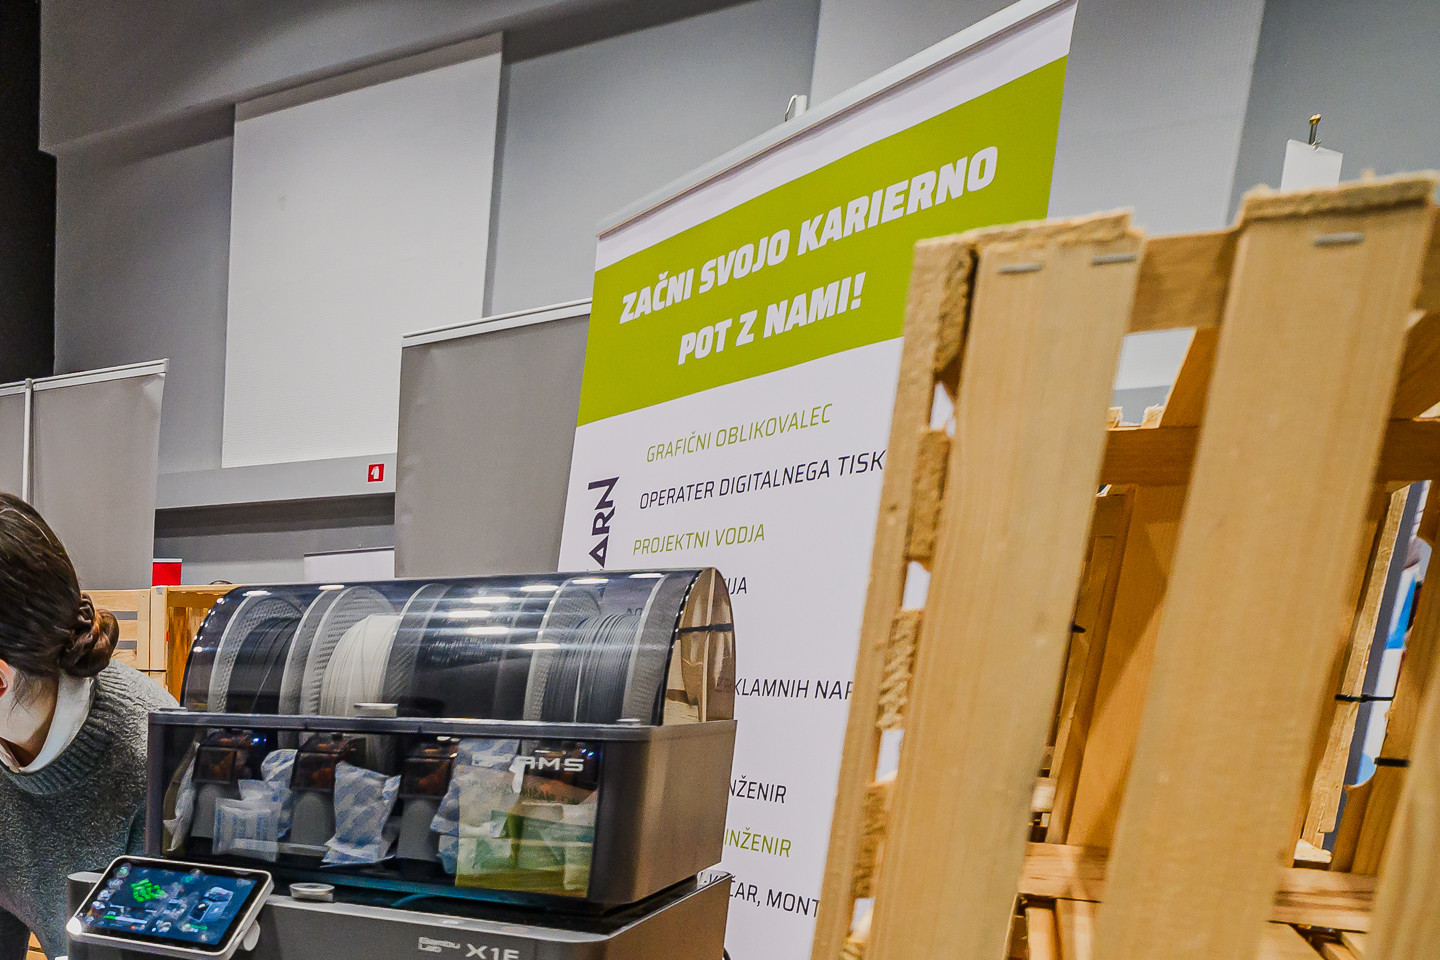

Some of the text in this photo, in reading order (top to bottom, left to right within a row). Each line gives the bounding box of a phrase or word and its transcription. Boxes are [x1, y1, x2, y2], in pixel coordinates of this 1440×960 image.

[619, 146, 999, 324] ZAČNI SVOJO KARIERNO
[677, 272, 867, 366] POT Z NAMI!
[646, 403, 833, 463] GRAFIČNI OBLIKOVALEC
[639, 449, 887, 510] OPERATER DIGITALNEGA TISK
[588, 476, 620, 569] ARN
[632, 523, 766, 556] PROJEKTNI VODJA
[735, 678, 810, 699] KLAMNIH
[514, 755, 585, 772] AMS
[729, 775, 788, 804] NŽENIR
[724, 826, 792, 858] INŽENIR
[766, 888, 820, 918] MONT
